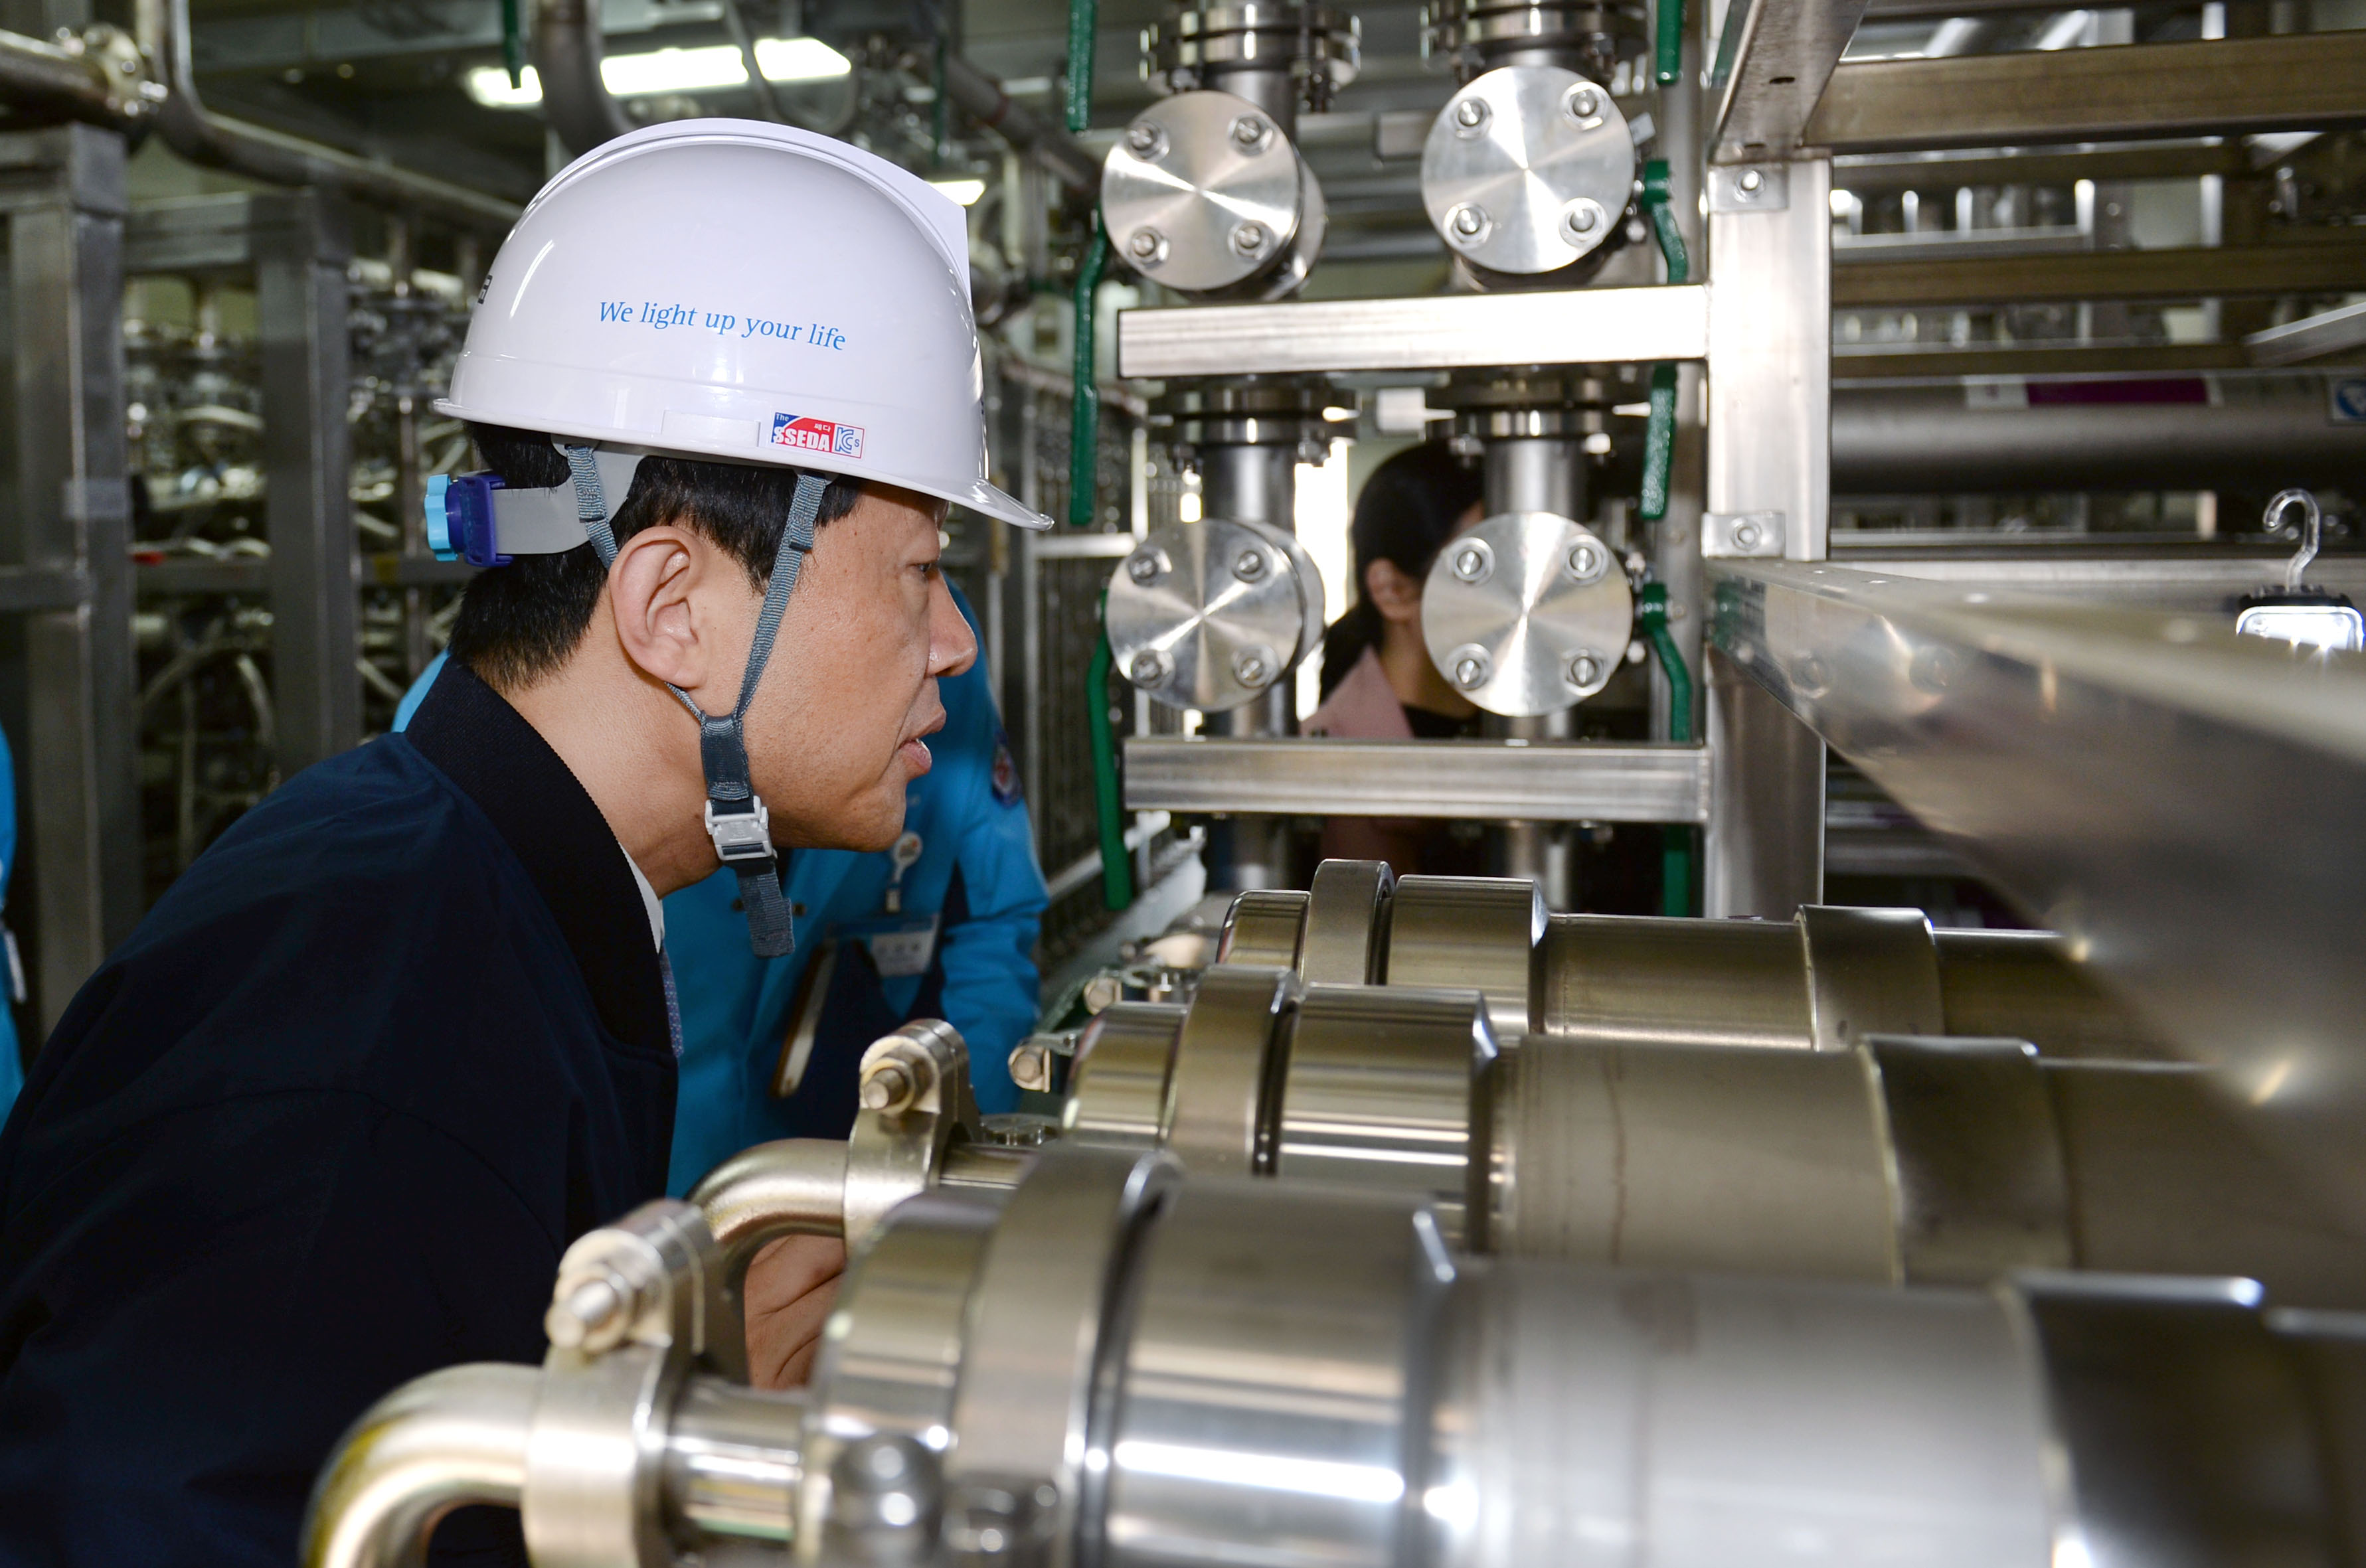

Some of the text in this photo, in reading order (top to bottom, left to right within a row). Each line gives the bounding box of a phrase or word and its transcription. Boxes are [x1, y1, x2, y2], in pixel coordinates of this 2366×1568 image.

[600, 301, 845, 350] We light up your life
[776, 413, 790, 422] The
[774, 426, 830, 451] SSEDA
